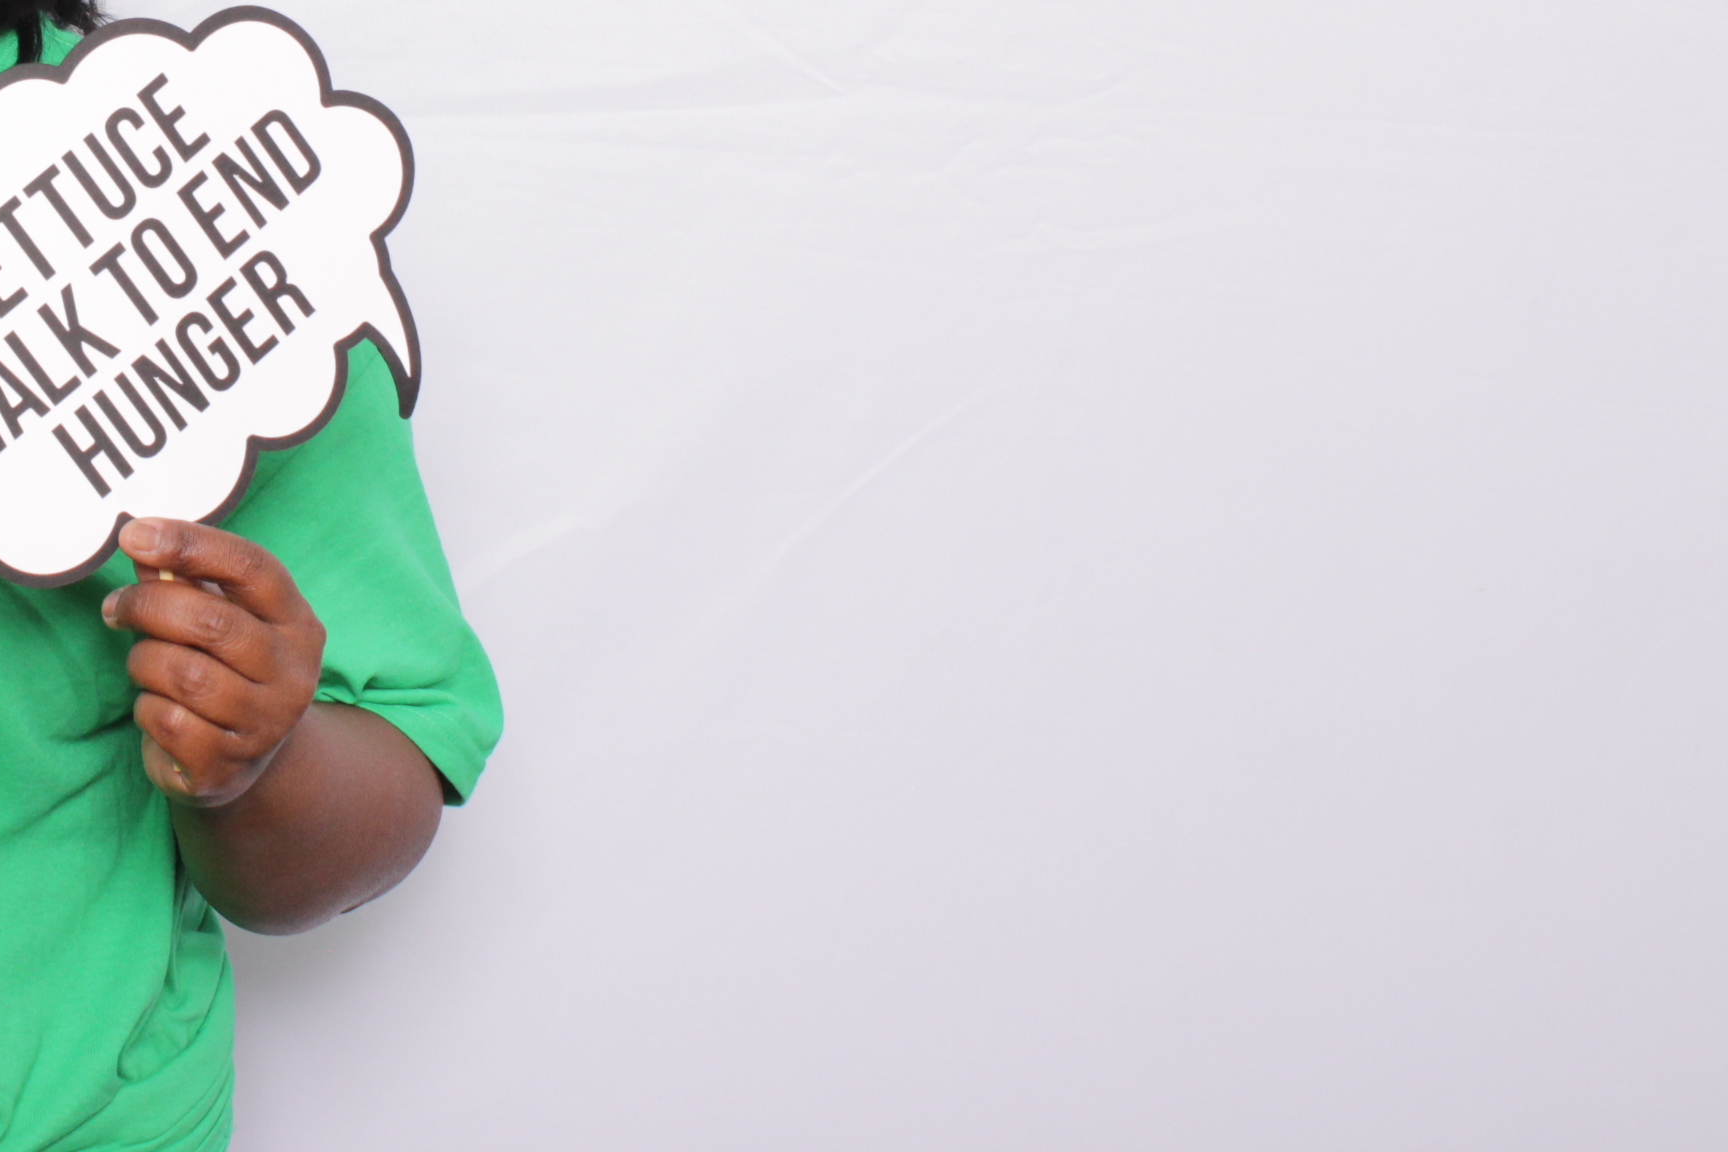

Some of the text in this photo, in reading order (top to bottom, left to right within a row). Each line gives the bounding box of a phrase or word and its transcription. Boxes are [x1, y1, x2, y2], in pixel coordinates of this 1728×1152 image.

[88, 217, 198, 326] TO
[177, 109, 322, 260] END
[51, 250, 316, 498] HUNGER
